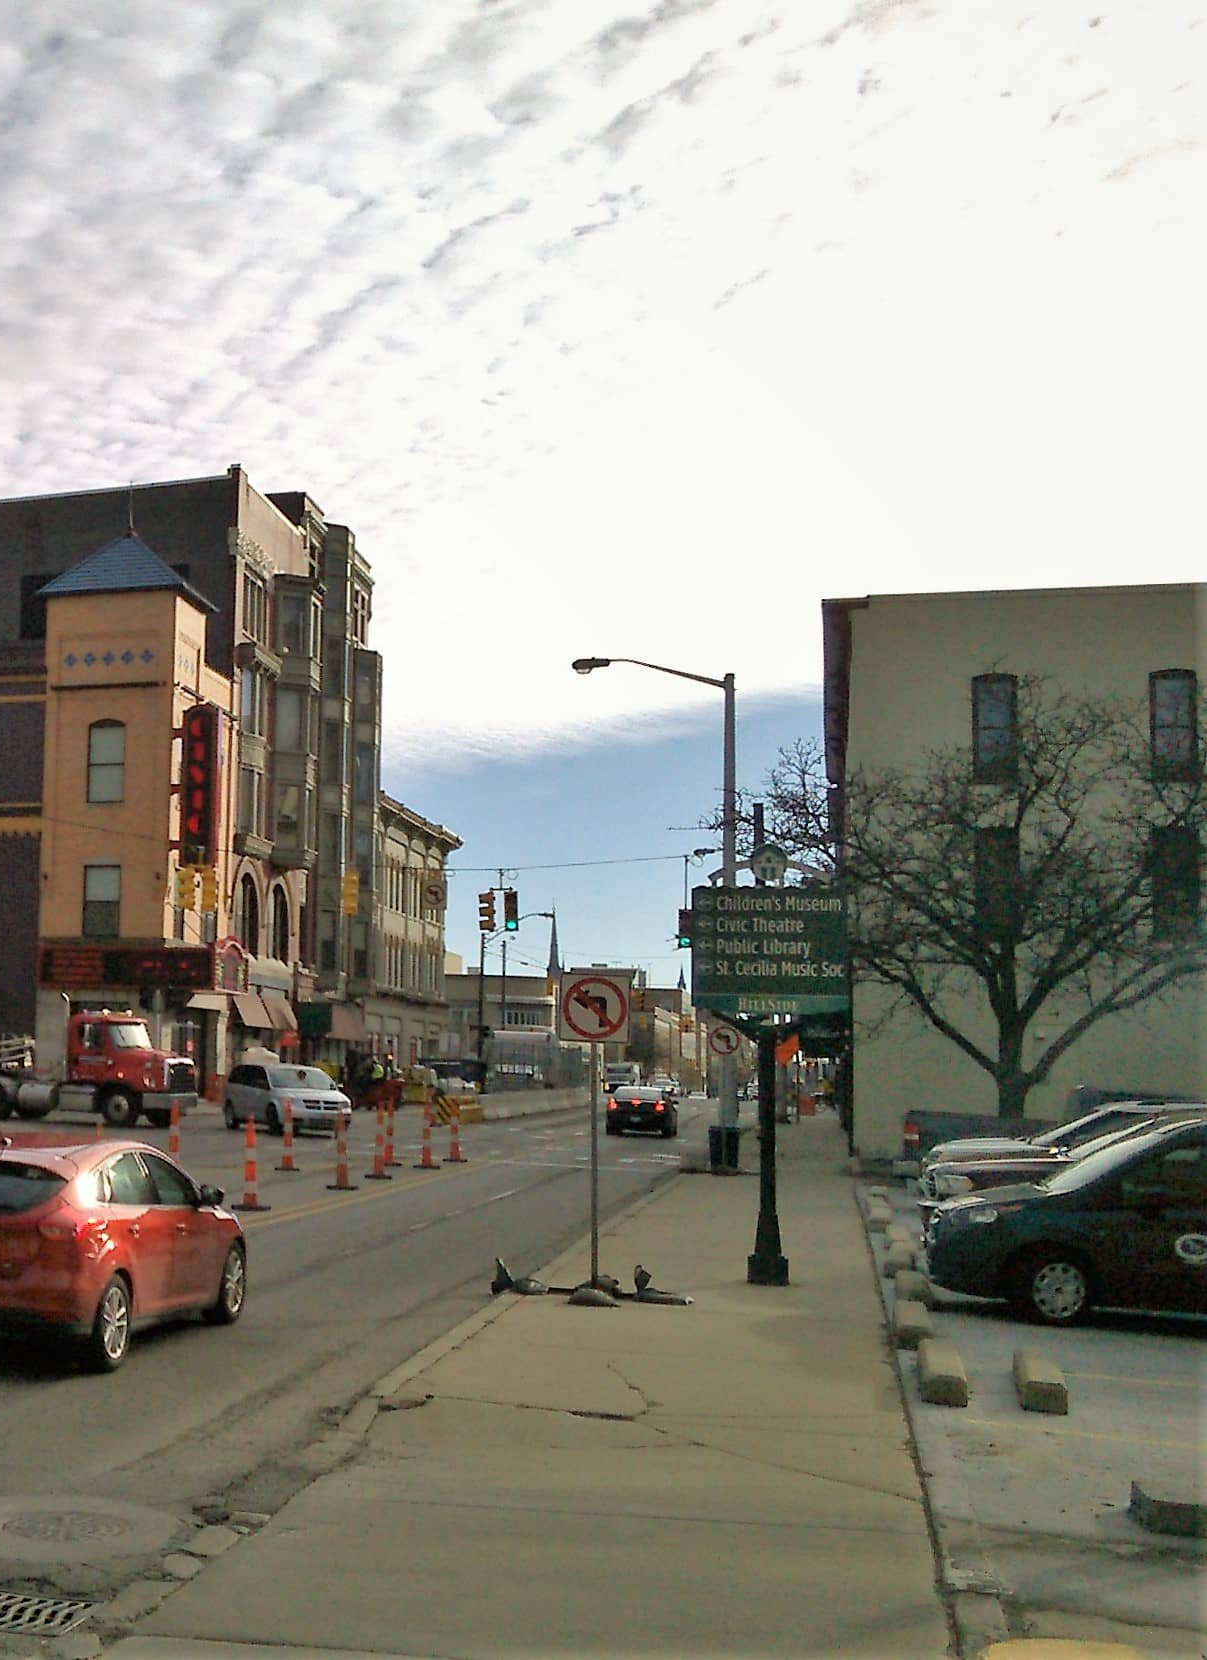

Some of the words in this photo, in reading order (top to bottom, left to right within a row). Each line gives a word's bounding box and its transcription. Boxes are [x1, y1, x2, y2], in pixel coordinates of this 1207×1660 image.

[716, 895, 781, 912] Children's
[785, 896, 842, 912] Museum
[716, 917, 748, 933] Civic
[752, 917, 805, 933] Theatre
[716, 938, 759, 954] Public
[763, 938, 811, 959] Library
[735, 960, 777, 976] Cecilia
[781, 960, 818, 977] Music
